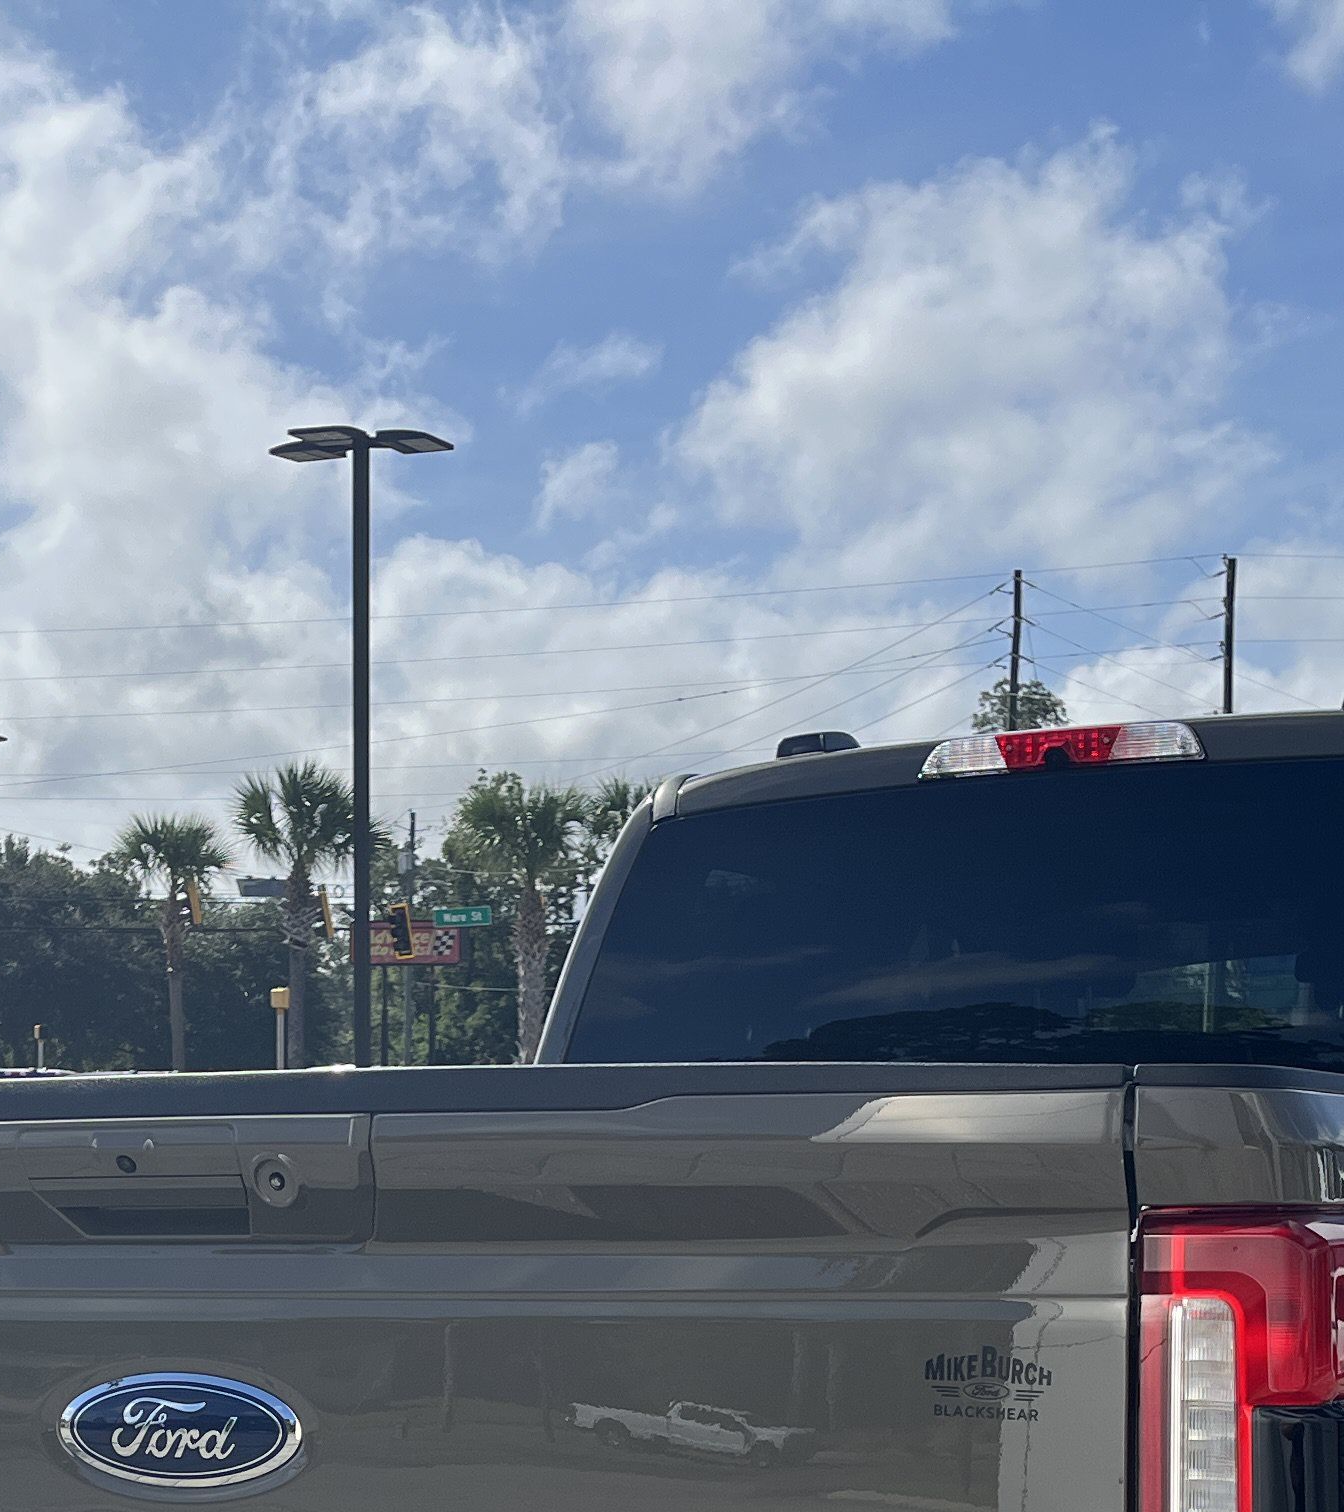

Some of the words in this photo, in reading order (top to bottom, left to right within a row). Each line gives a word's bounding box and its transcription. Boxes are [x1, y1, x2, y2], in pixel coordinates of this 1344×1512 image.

[971, 1385, 1001, 1397] Ford
[933, 1404, 1039, 1422] BLACKSHEAR
[112, 1397, 237, 1460] Ford
